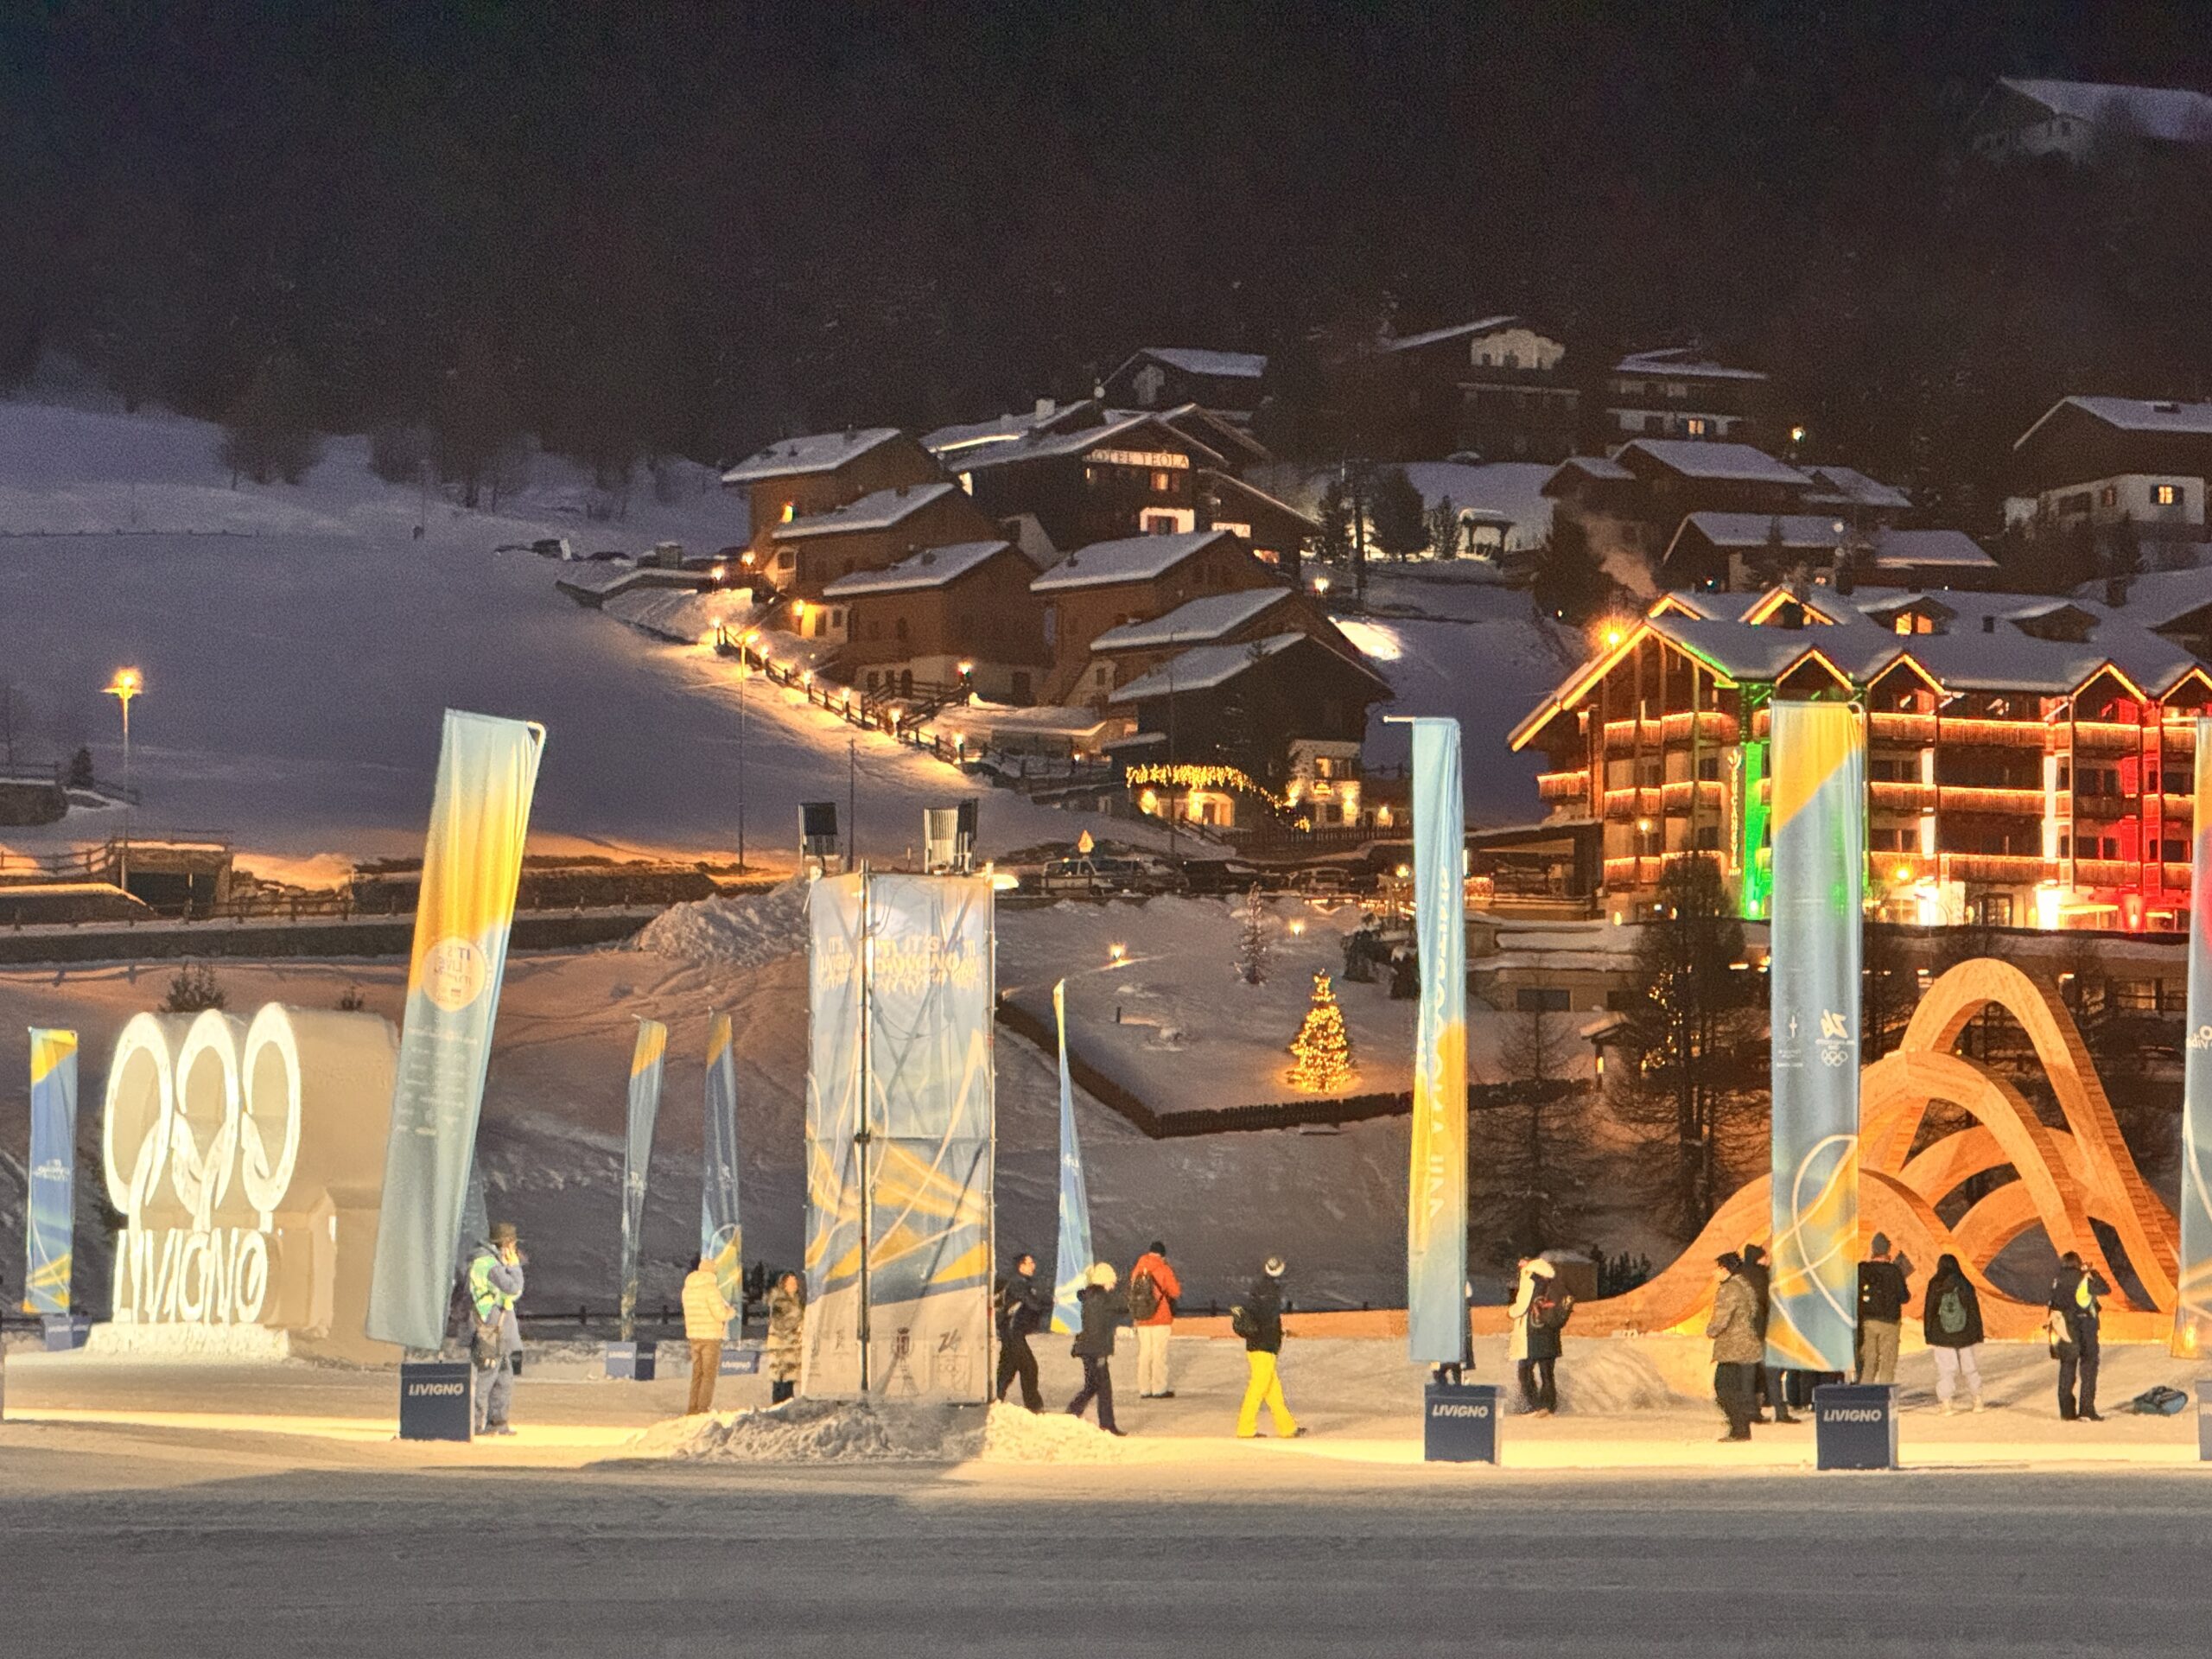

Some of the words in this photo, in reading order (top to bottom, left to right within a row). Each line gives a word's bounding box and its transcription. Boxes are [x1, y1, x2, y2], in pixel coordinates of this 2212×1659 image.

[408, 1382, 464, 1396] LIVIGNO
[1433, 1404, 1489, 1419] LIVIGNO
[1823, 1409, 1882, 1422] LIVIGNO
